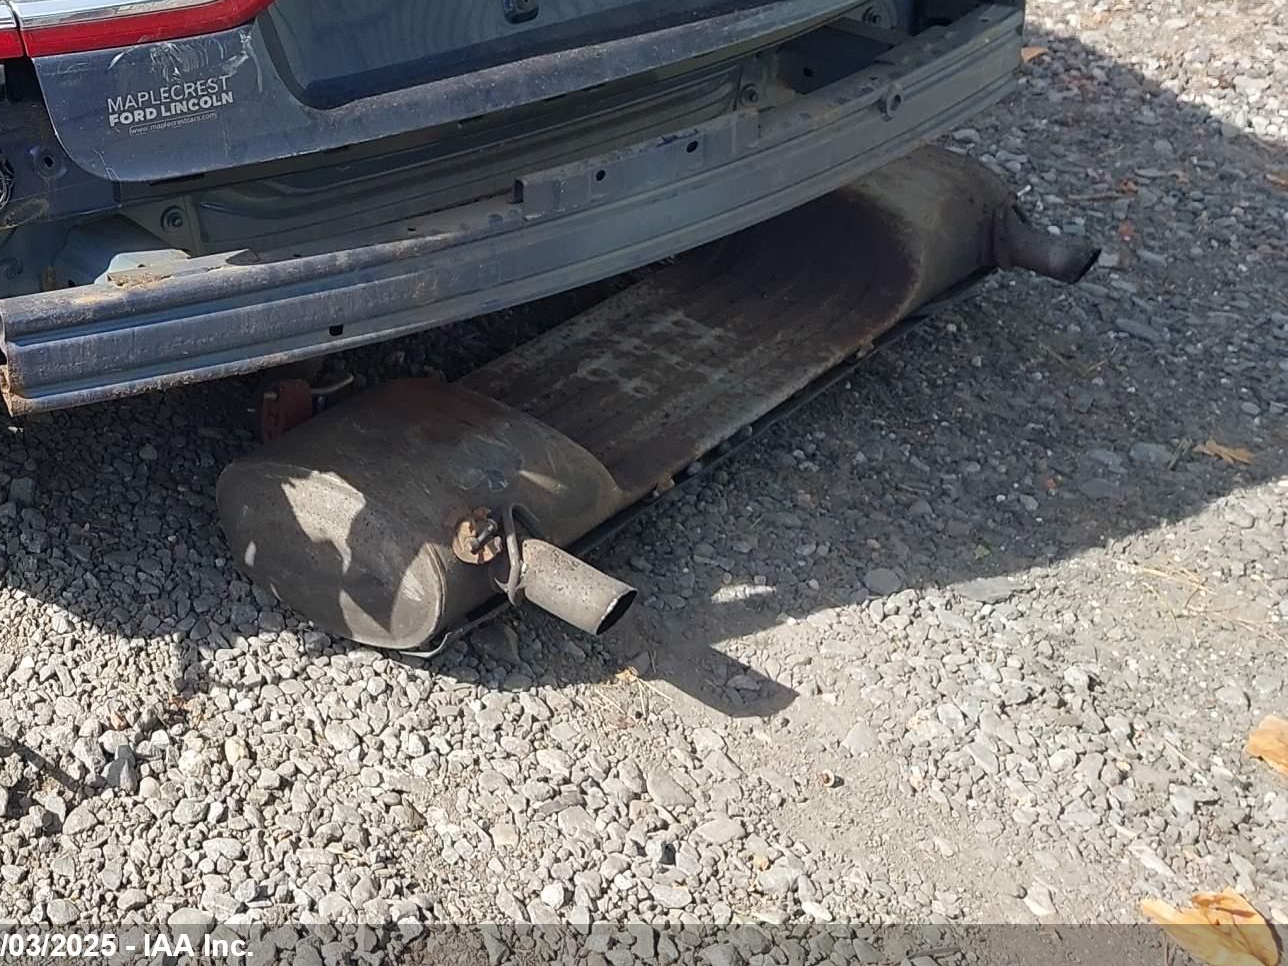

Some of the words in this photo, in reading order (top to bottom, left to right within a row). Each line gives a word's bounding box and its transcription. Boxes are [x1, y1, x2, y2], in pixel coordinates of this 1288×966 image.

[107, 75, 232, 114] MAPLECREST
[108, 107, 158, 127] FORD
[161, 91, 234, 117] LINCOLN
